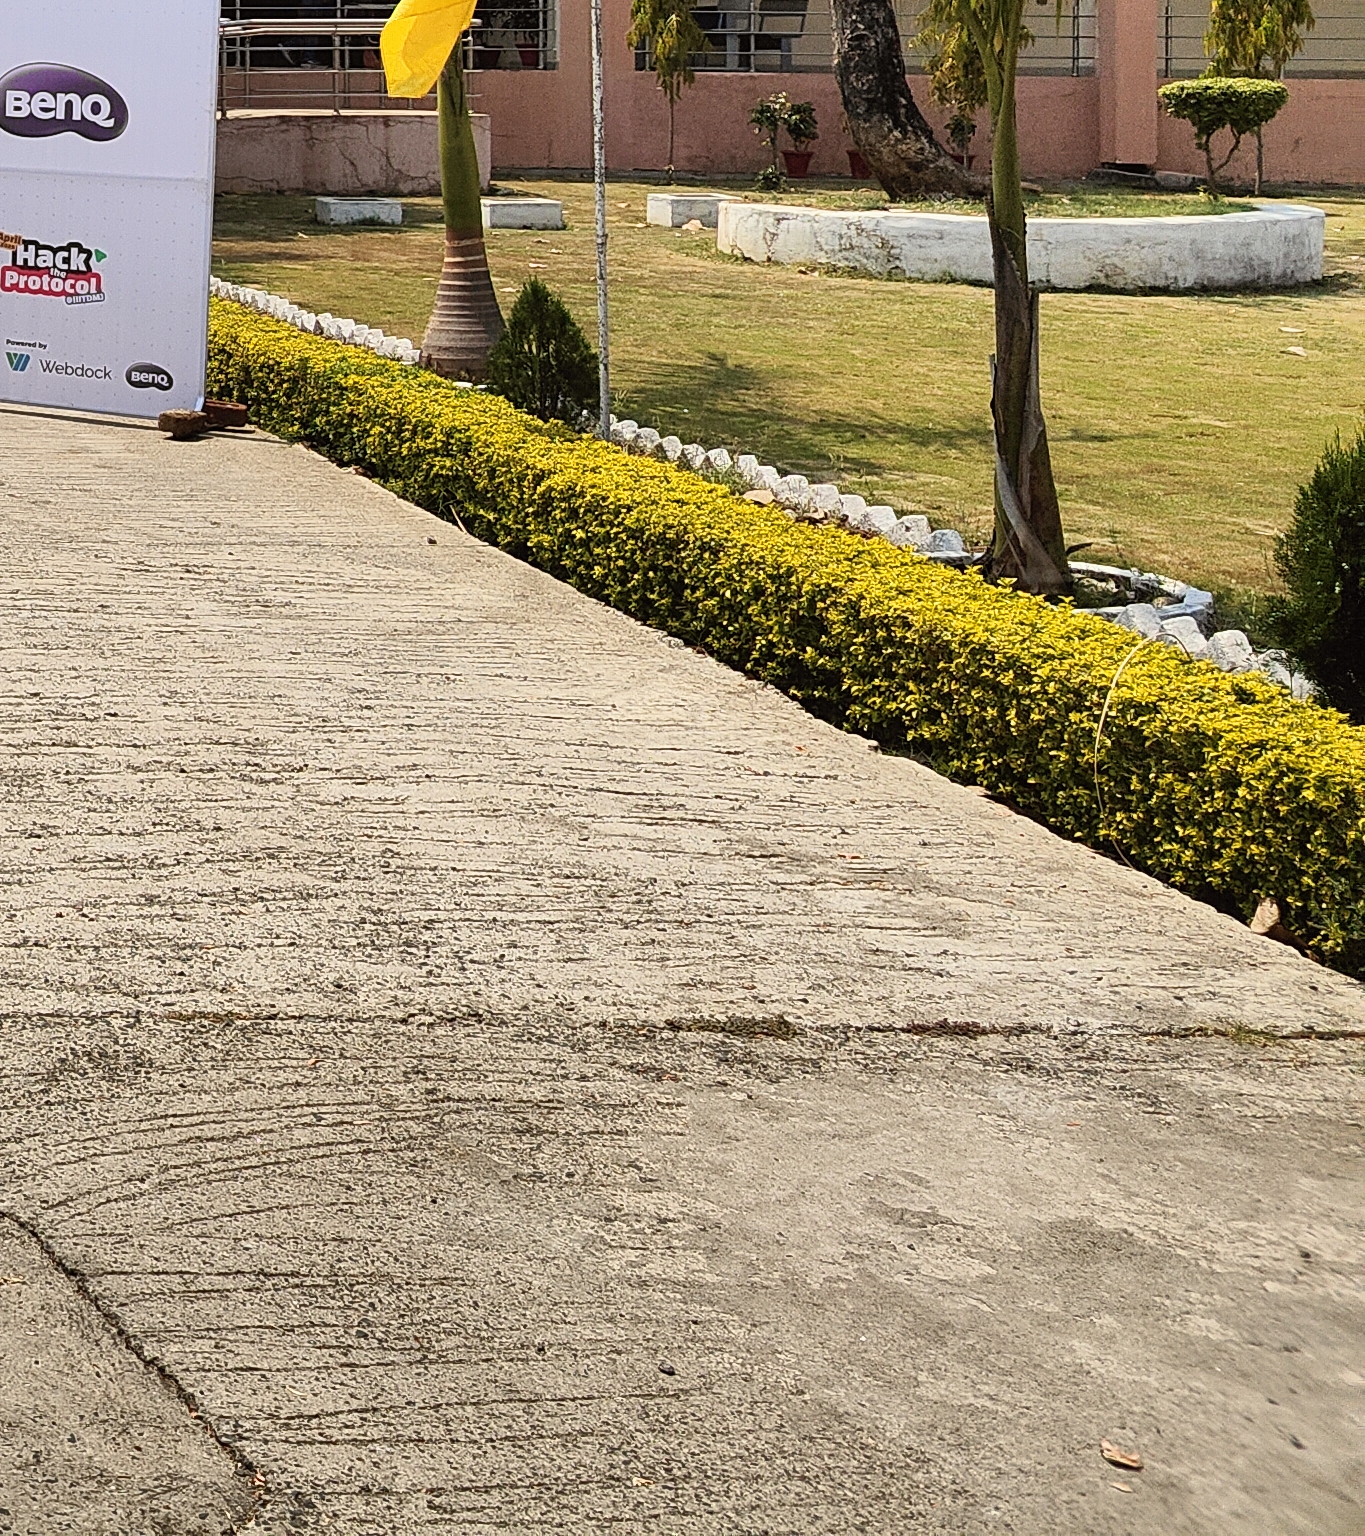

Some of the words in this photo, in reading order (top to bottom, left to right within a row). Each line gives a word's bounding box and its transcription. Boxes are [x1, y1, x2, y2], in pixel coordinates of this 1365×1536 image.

[5, 90, 115, 128] BenQ
[16, 244, 88, 271] Hack
[4, 270, 98, 294] Protocol
[50, 267, 67, 279] the
[5, 338, 37, 348] Powered
[38, 341, 48, 350] by
[39, 359, 113, 380] Webdock
[131, 371, 169, 384] BenQ
